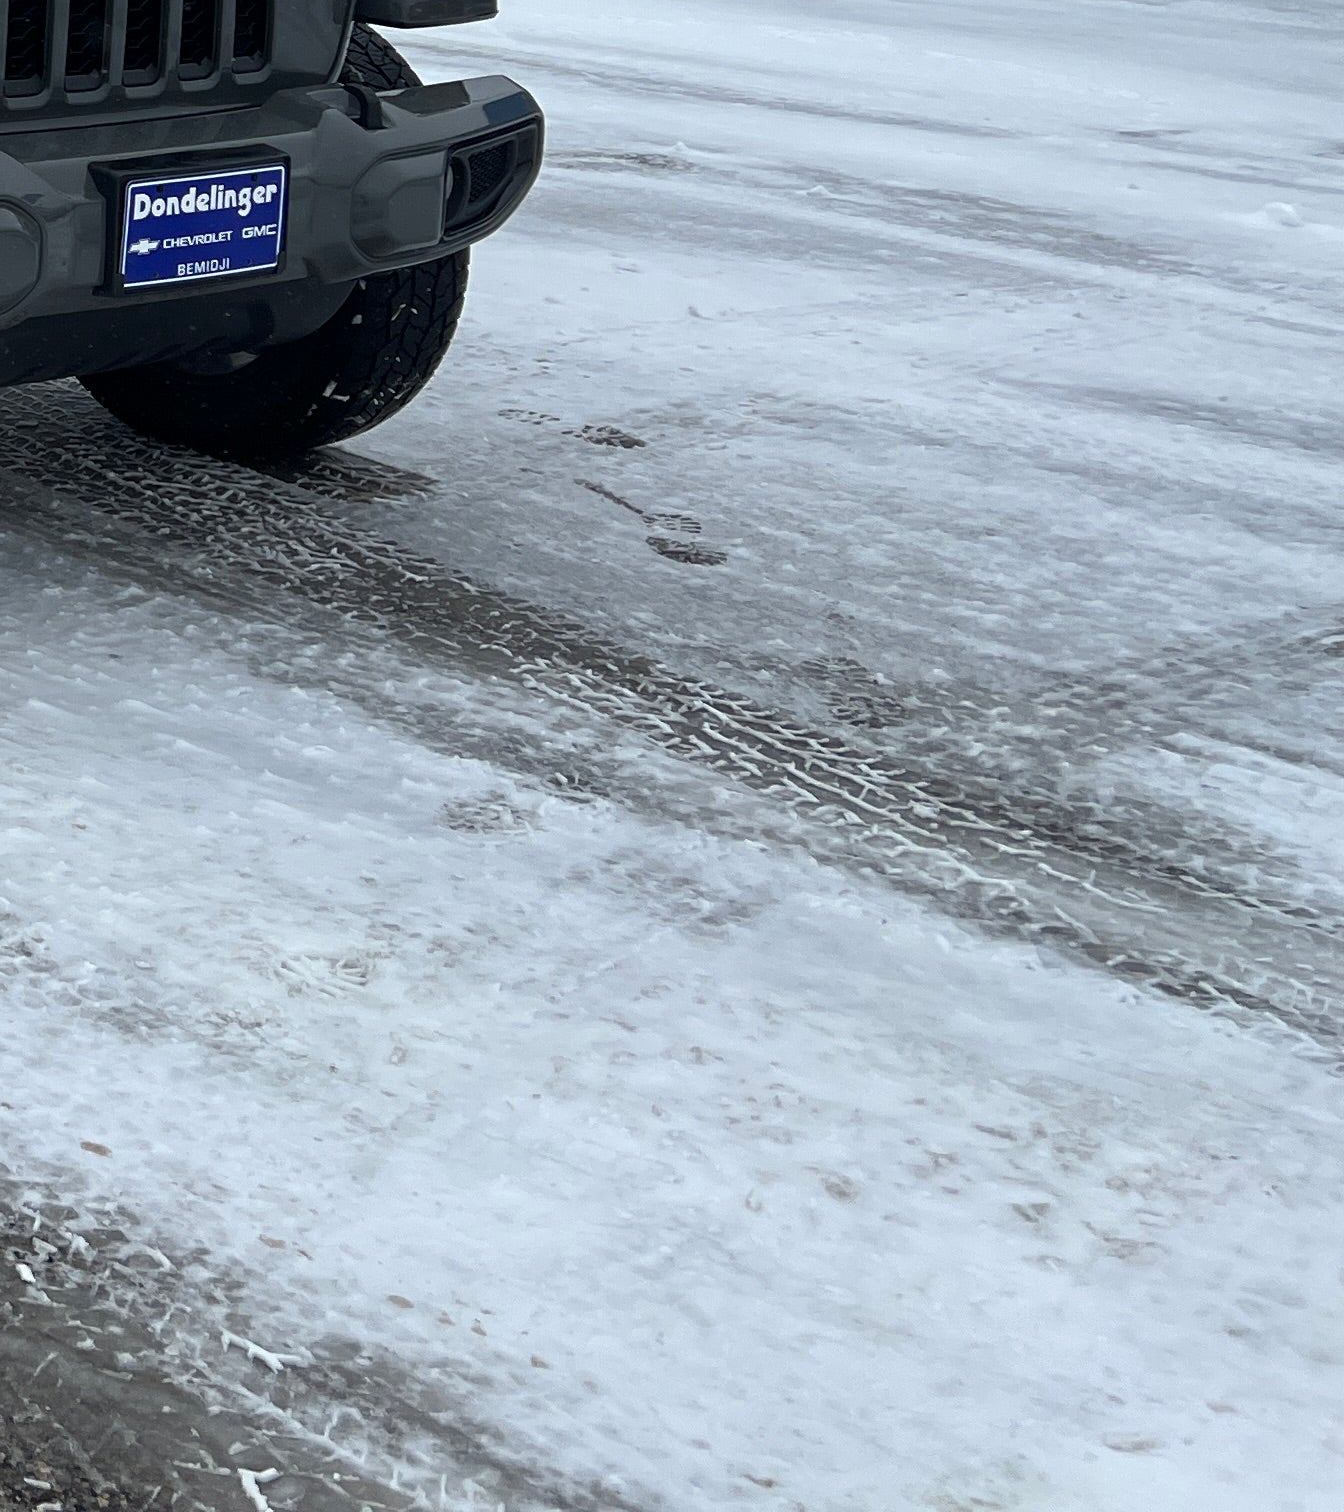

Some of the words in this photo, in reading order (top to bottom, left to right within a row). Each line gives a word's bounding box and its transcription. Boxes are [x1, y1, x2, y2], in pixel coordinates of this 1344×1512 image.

[133, 184, 278, 221] Dondelinger
[162, 230, 234, 249] CHEVROLET
[241, 223, 278, 239] GMC
[177, 257, 230, 276] BEMIDJI
